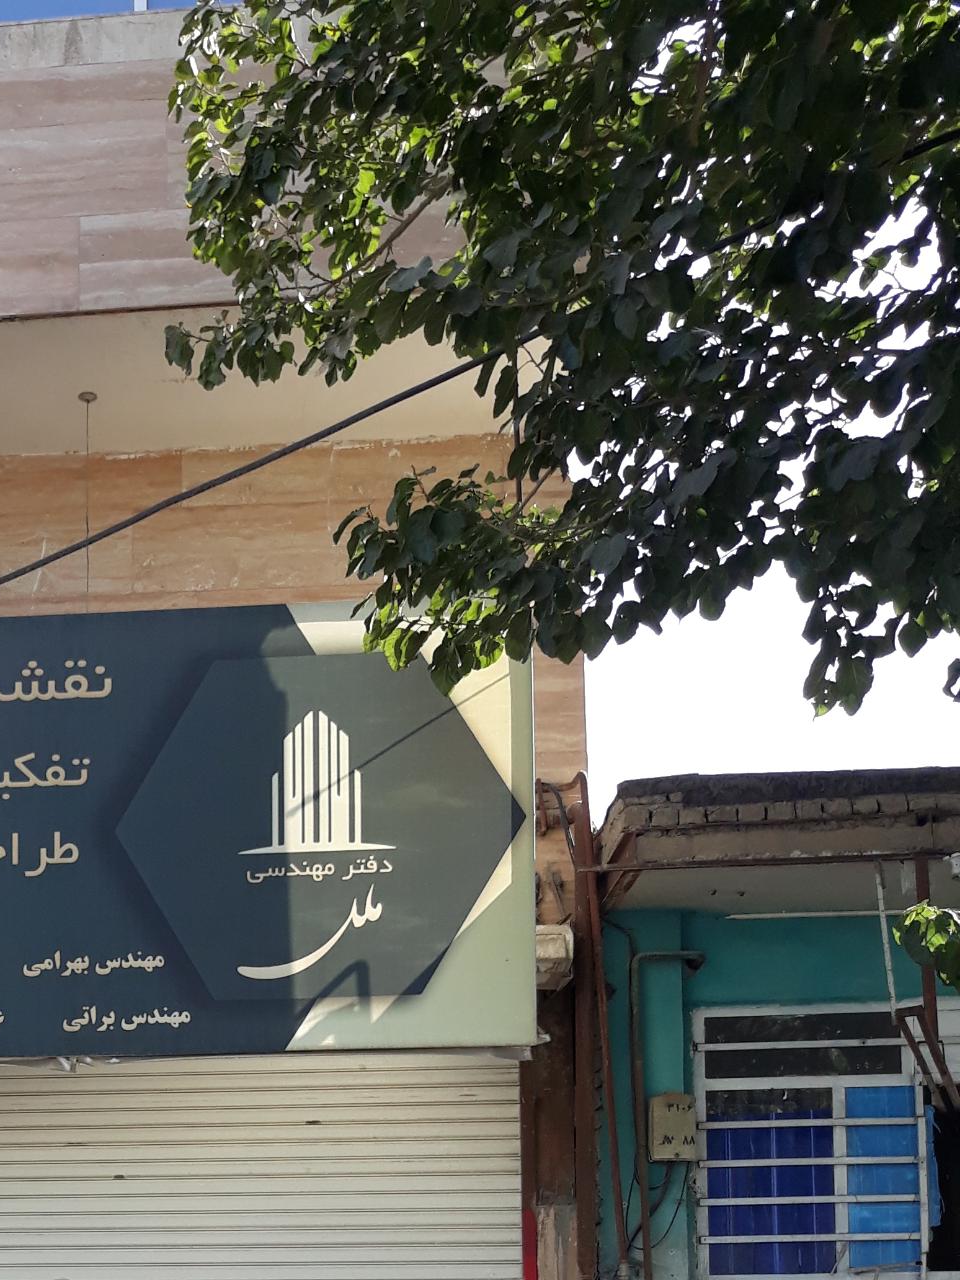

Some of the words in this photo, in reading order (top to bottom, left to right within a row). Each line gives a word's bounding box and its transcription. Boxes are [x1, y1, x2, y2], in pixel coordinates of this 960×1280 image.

[246, 860, 336, 884] مهندسی
[342, 855, 394, 881] دفتر
[237, 883, 383, 980] ملل
[22, 949, 90, 977] بهرامی
[95, 950, 165, 976] مهندس
[62, 1005, 116, 1032] براتی
[120, 1006, 191, 1031] مهندس
